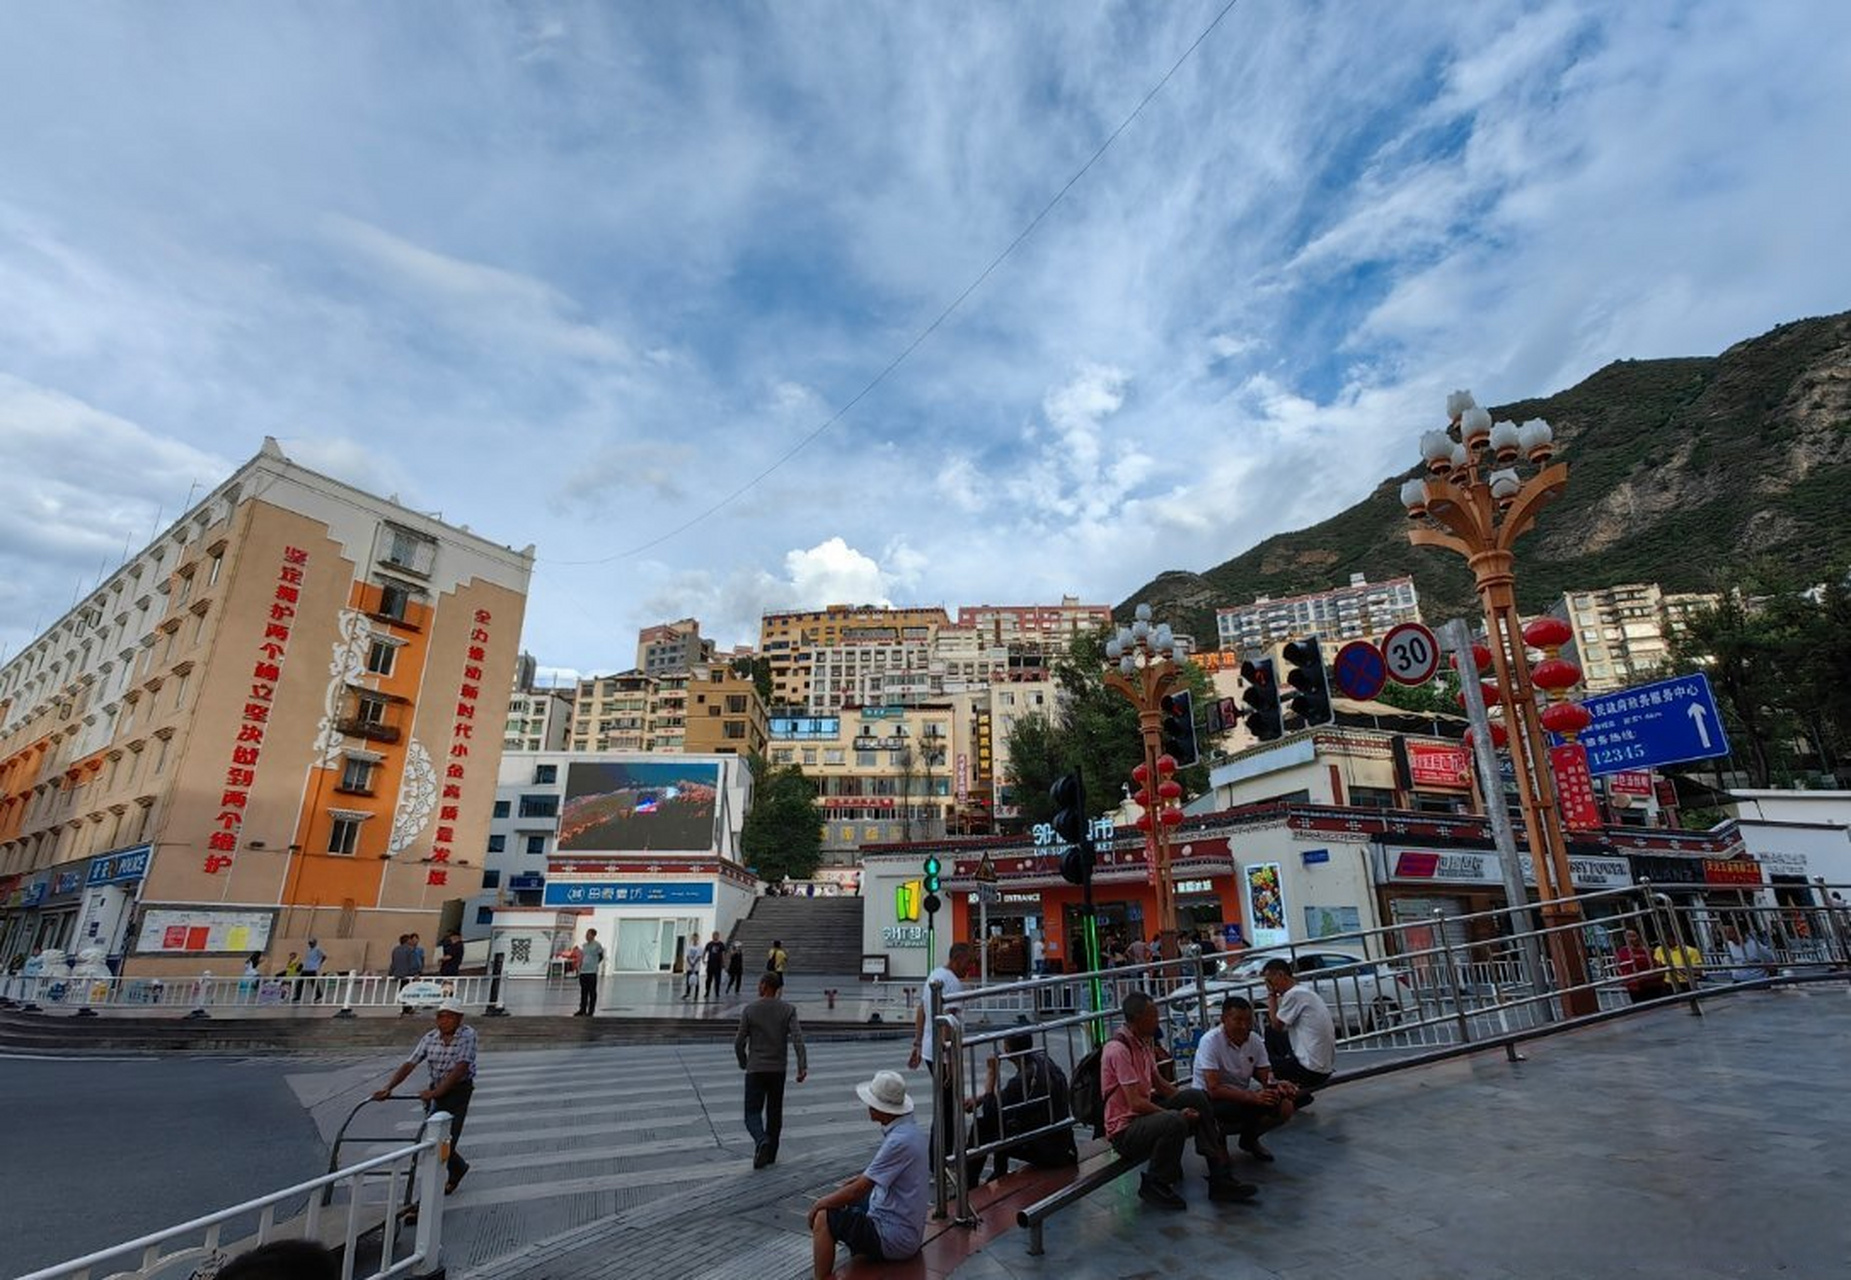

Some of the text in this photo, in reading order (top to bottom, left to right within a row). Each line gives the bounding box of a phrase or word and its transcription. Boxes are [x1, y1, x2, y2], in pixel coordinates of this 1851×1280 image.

[1393, 637, 1427, 671] 30
[426, 609, 492, 886] 全力推动新时代小金高质量发展
[1594, 744, 1645, 765] 12345
